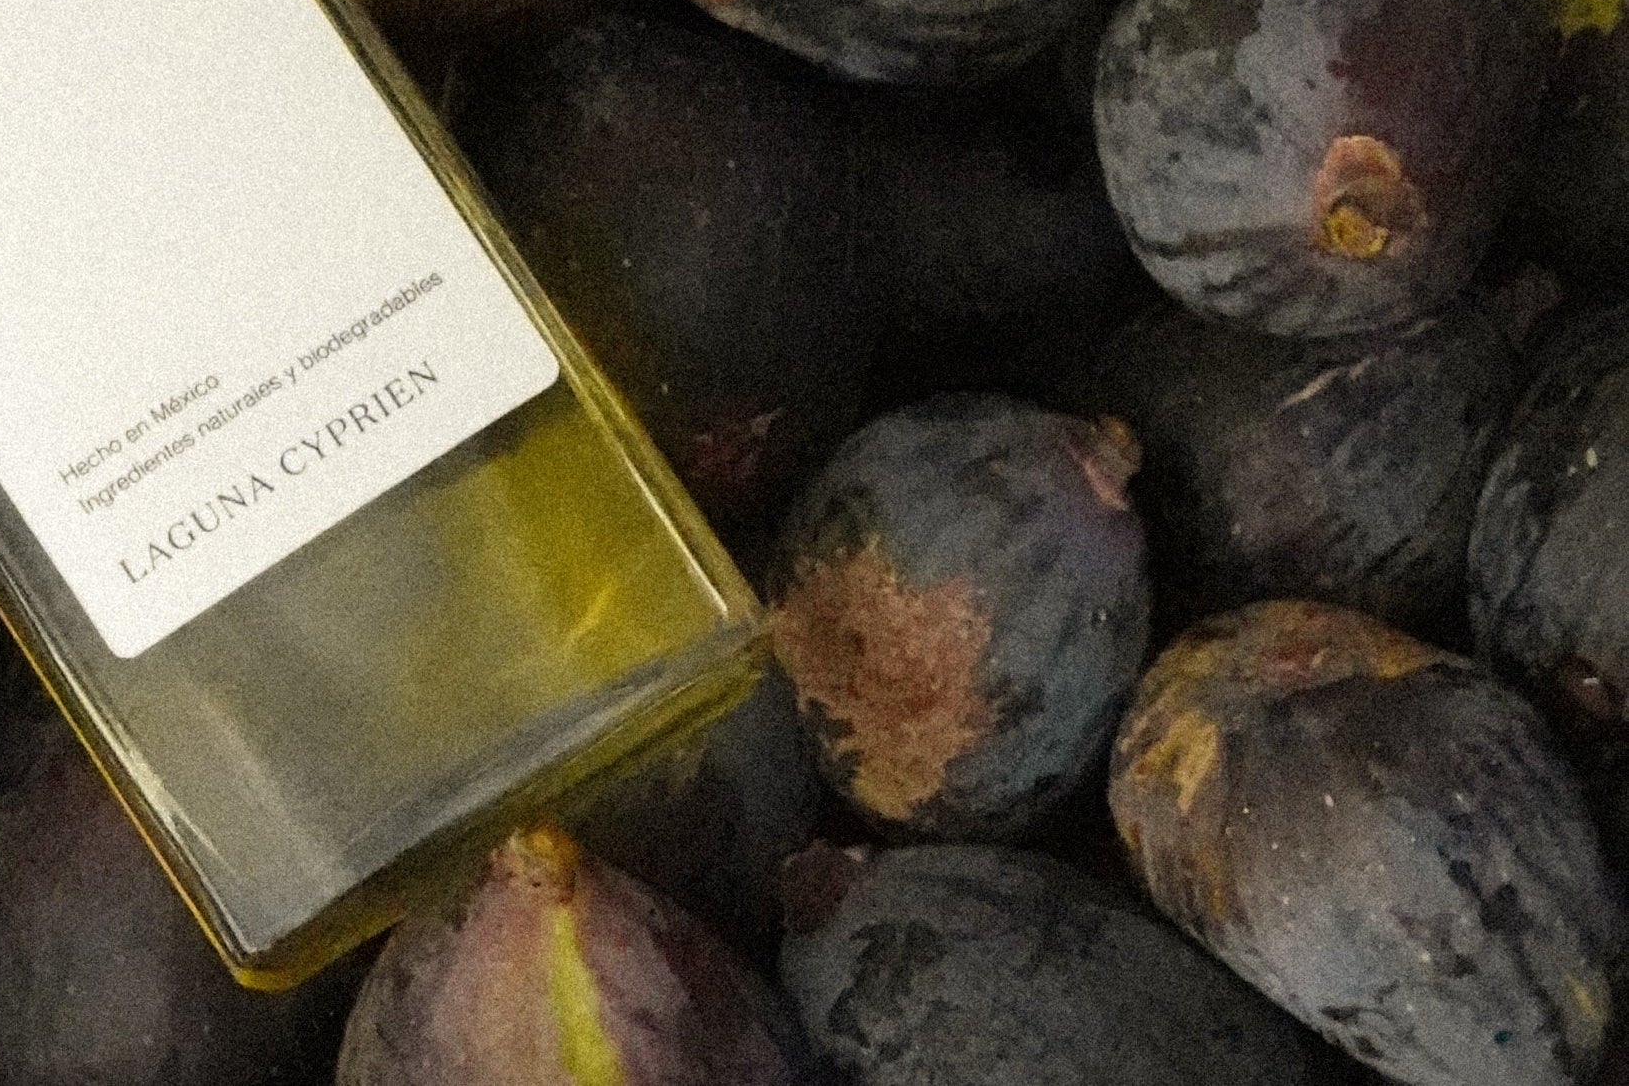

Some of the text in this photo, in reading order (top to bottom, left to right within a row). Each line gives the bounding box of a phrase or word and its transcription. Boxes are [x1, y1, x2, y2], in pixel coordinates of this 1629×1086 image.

[59, 374, 220, 486] Hecho en México
[78, 271, 444, 515] Ingredientes naturales y biodegradables
[118, 360, 440, 584] LAGUNA CYPRIEN
